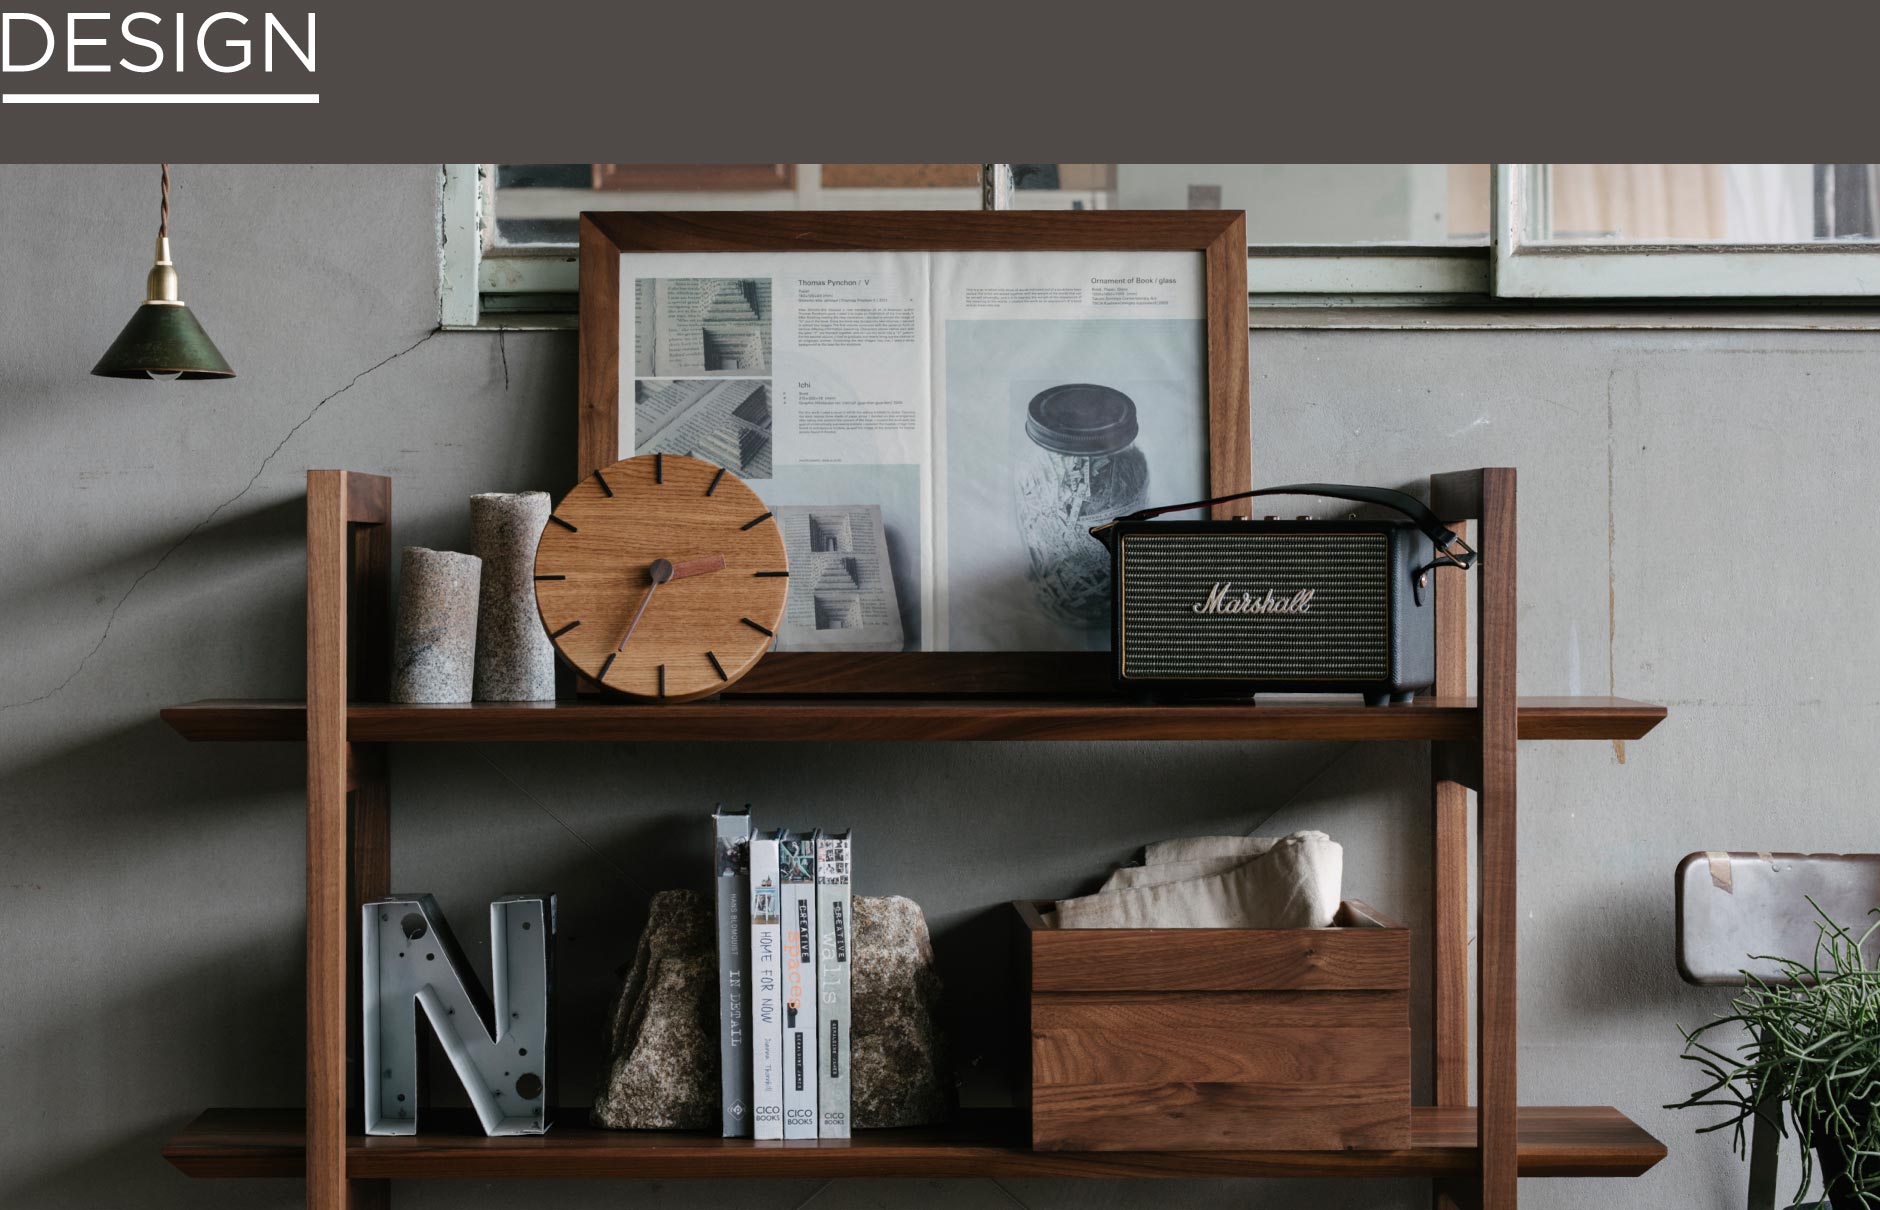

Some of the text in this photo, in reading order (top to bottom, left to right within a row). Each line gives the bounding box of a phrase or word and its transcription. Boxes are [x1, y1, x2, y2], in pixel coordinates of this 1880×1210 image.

[798, 279, 826, 287] Thomas
[827, 279, 857, 288] Pynchon
[1091, 277, 1126, 285] Ornament
[1158, 277, 1177, 286] glass
[798, 381, 811, 389] Ichi
[1193, 581, 1315, 614] Marshall
[729, 893, 739, 955] HANS BLOMQUIST
[799, 905, 809, 958] CREATIVE
[834, 906, 845, 959] CREATIVE
[759, 931, 774, 1024] HOME FOR NOW
[783, 930, 802, 1009] spaces
[822, 931, 842, 1005] walls
[363, 894, 550, 1136] N
[729, 970, 742, 1047] IN DETAIL
[755, 1106, 780, 1115] CICO
[787, 1109, 813, 1118] CICO
[787, 1118, 813, 1126] BOOKS
[824, 1112, 845, 1120] CICO
